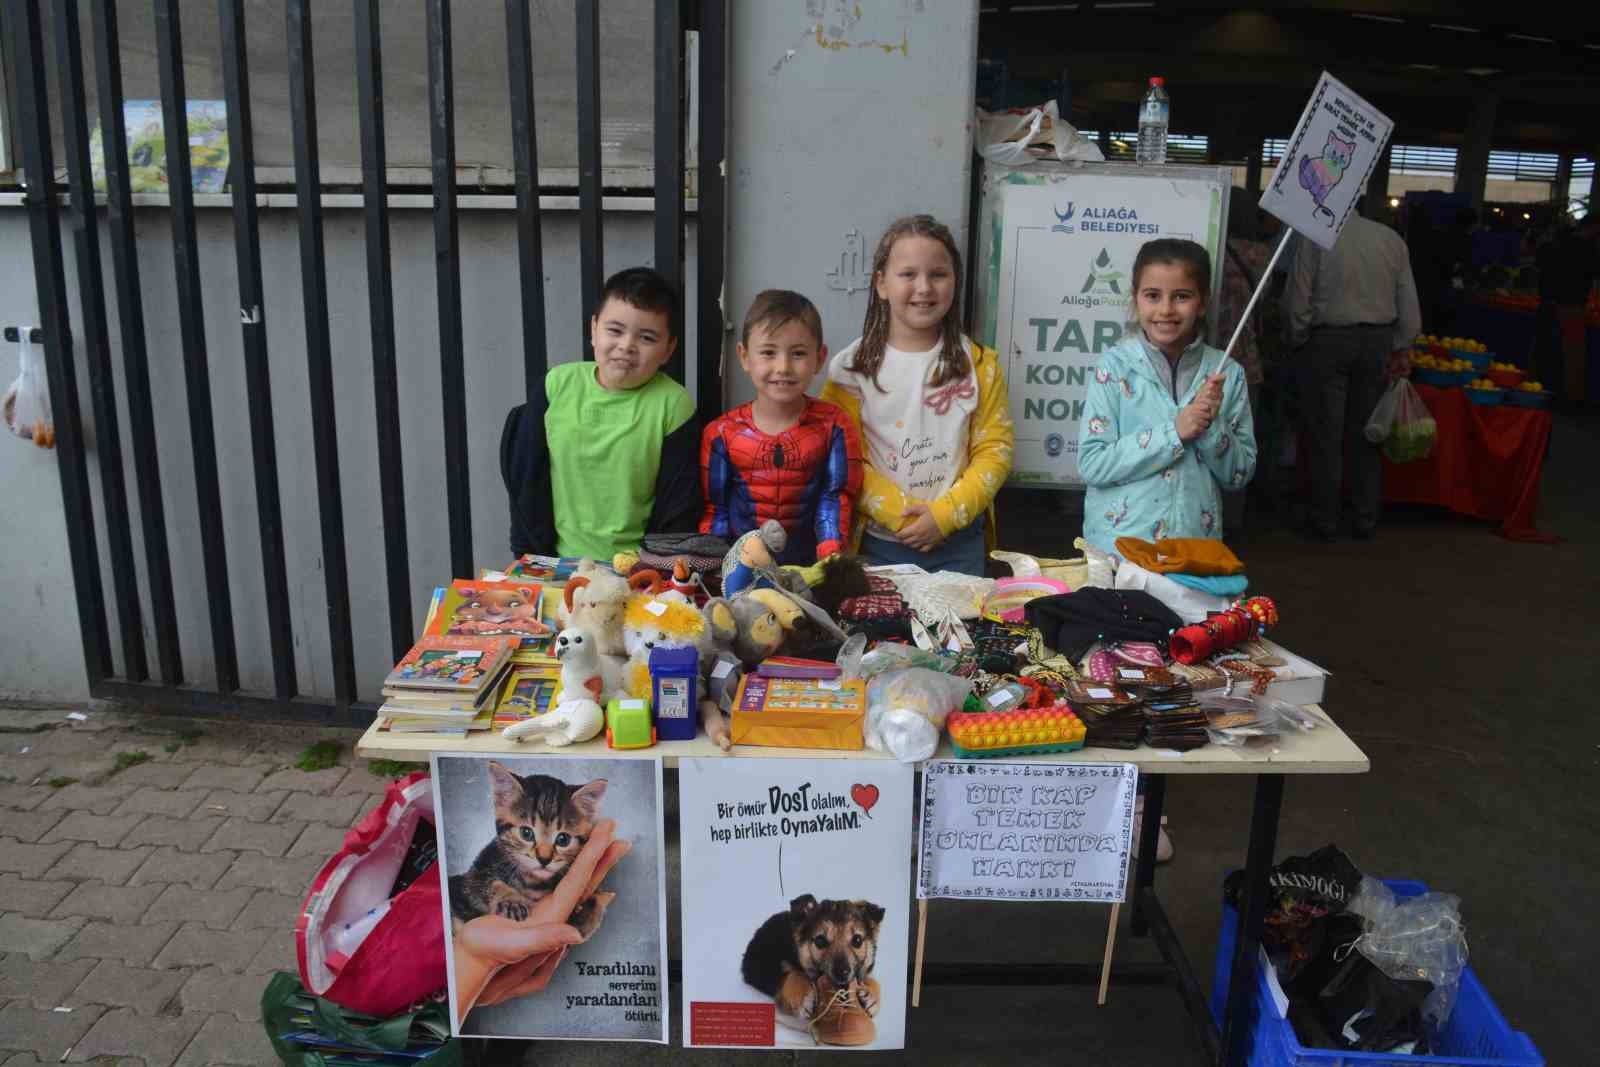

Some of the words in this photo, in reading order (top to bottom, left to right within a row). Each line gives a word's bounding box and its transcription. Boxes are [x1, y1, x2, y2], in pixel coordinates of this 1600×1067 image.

[1082, 206, 1138, 220] ALİAĞA
[1028, 318, 1128, 354] TAR
[1025, 364, 1094, 386] KON
[717, 802, 735, 819] Bir
[737, 800, 767, 817] ömür
[710, 826, 732, 844] hep
[734, 821, 778, 840] birlikte
[609, 979, 656, 991] severim
[566, 993, 658, 1009] yaradandan
